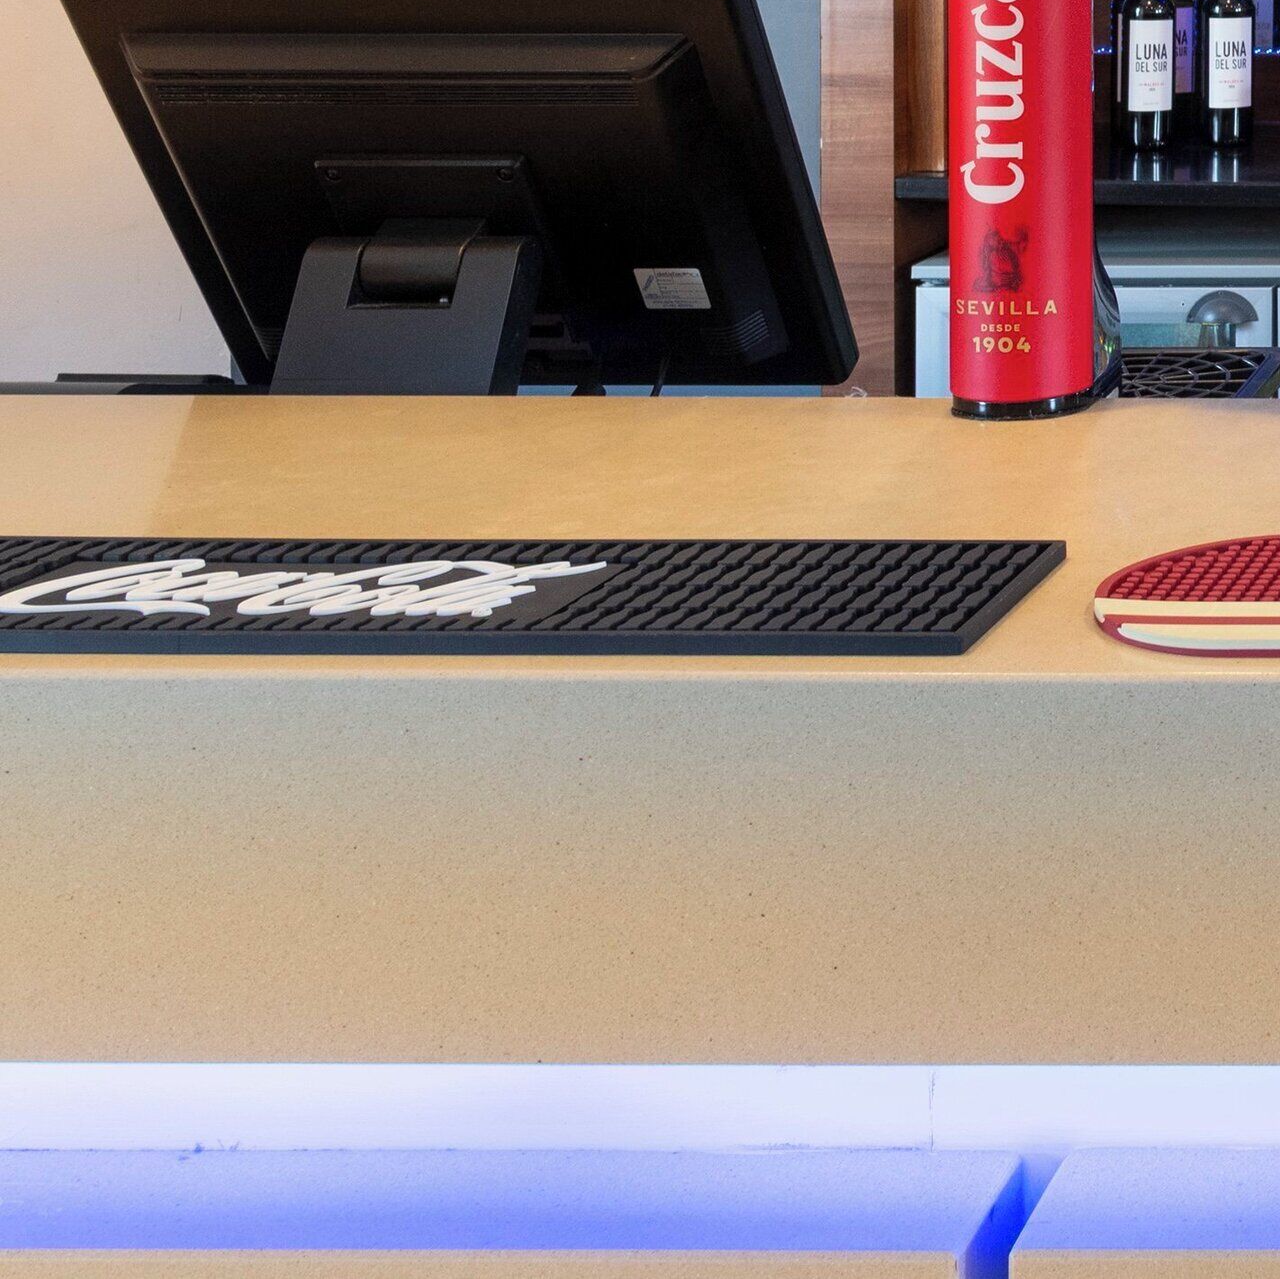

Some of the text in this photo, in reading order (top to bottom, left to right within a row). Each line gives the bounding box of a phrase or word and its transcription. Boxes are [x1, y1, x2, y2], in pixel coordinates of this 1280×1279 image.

[1136, 44, 1167, 60] LUNA
[1215, 41, 1247, 57] LUNA
[1136, 62, 1167, 72] DEL SUR
[1215, 59, 1247, 69] DEL SUR
[956, 299, 1058, 316] SEVILLA
[980, 323, 1021, 332] DESDE
[972, 337, 1031, 353] 1904
